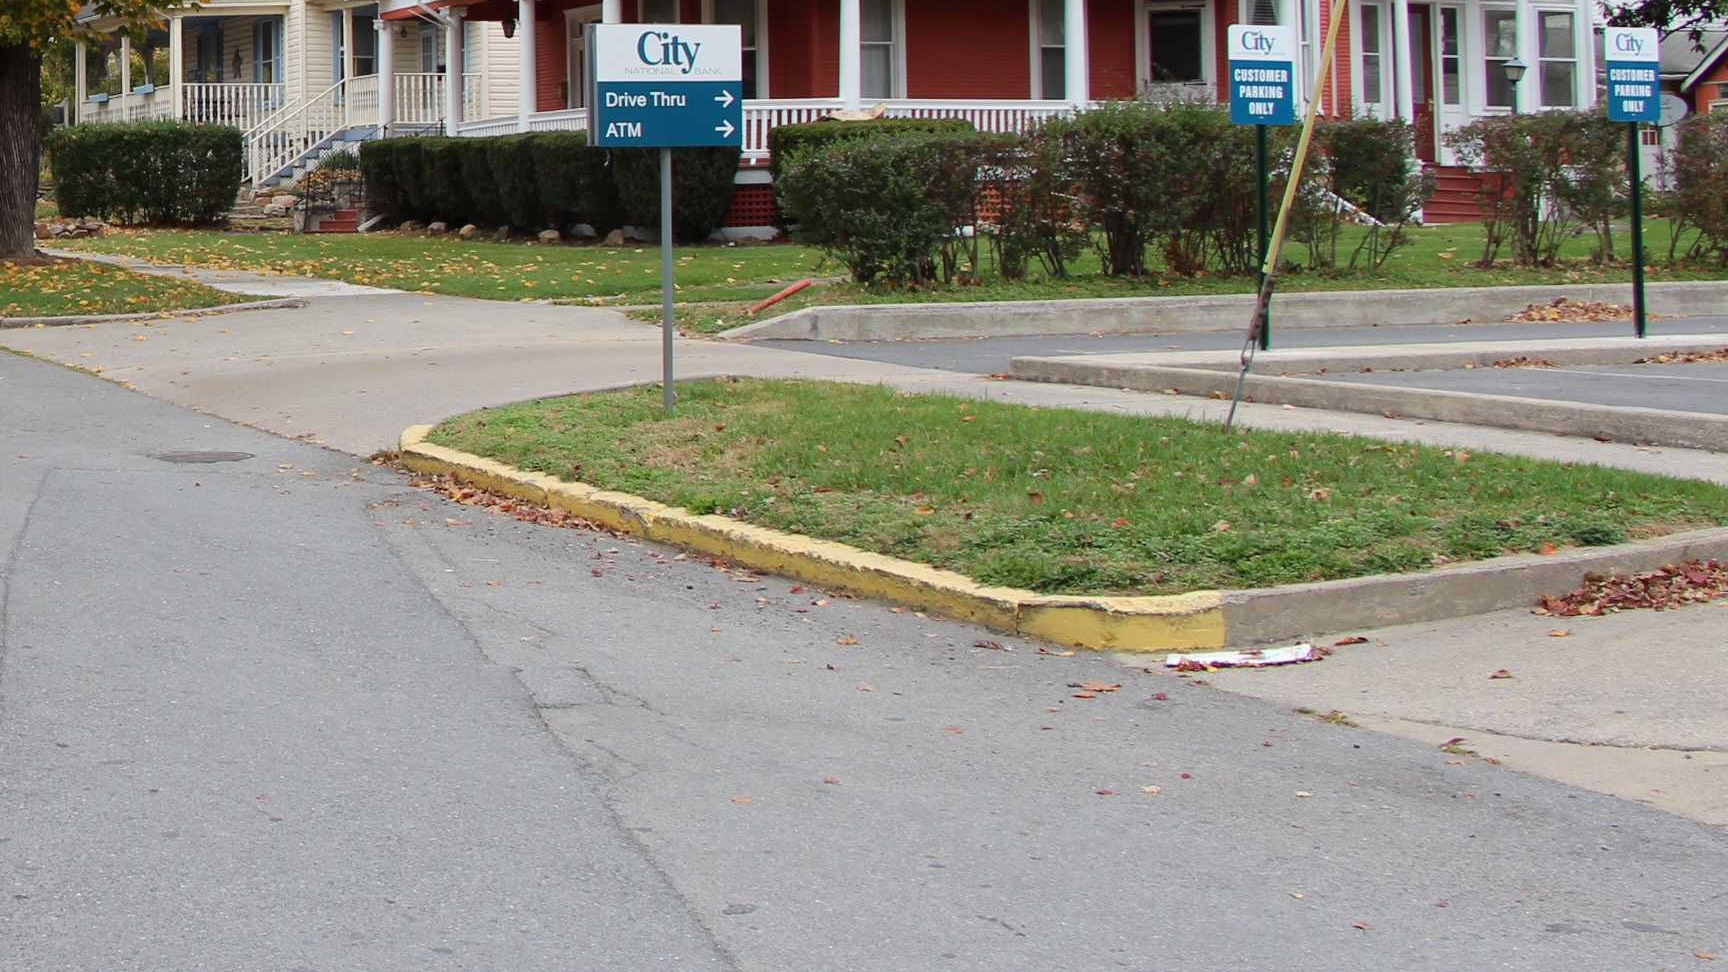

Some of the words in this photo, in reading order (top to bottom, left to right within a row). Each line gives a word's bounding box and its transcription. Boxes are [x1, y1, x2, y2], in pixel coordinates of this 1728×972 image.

[1241, 30, 1276, 55] City
[1615, 32, 1644, 56] City
[637, 31, 702, 74] City
[1234, 69, 1288, 82] CUSTOMER
[1610, 69, 1655, 81] CUSTOMER
[1239, 86, 1283, 98] PARKING
[1614, 85, 1651, 97] PARKING
[605, 92, 647, 107] Drive
[650, 92, 686, 107] Thru
[1622, 100, 1644, 112] ONLY
[1249, 102, 1275, 115] ONLY
[605, 123, 642, 137] ATM
